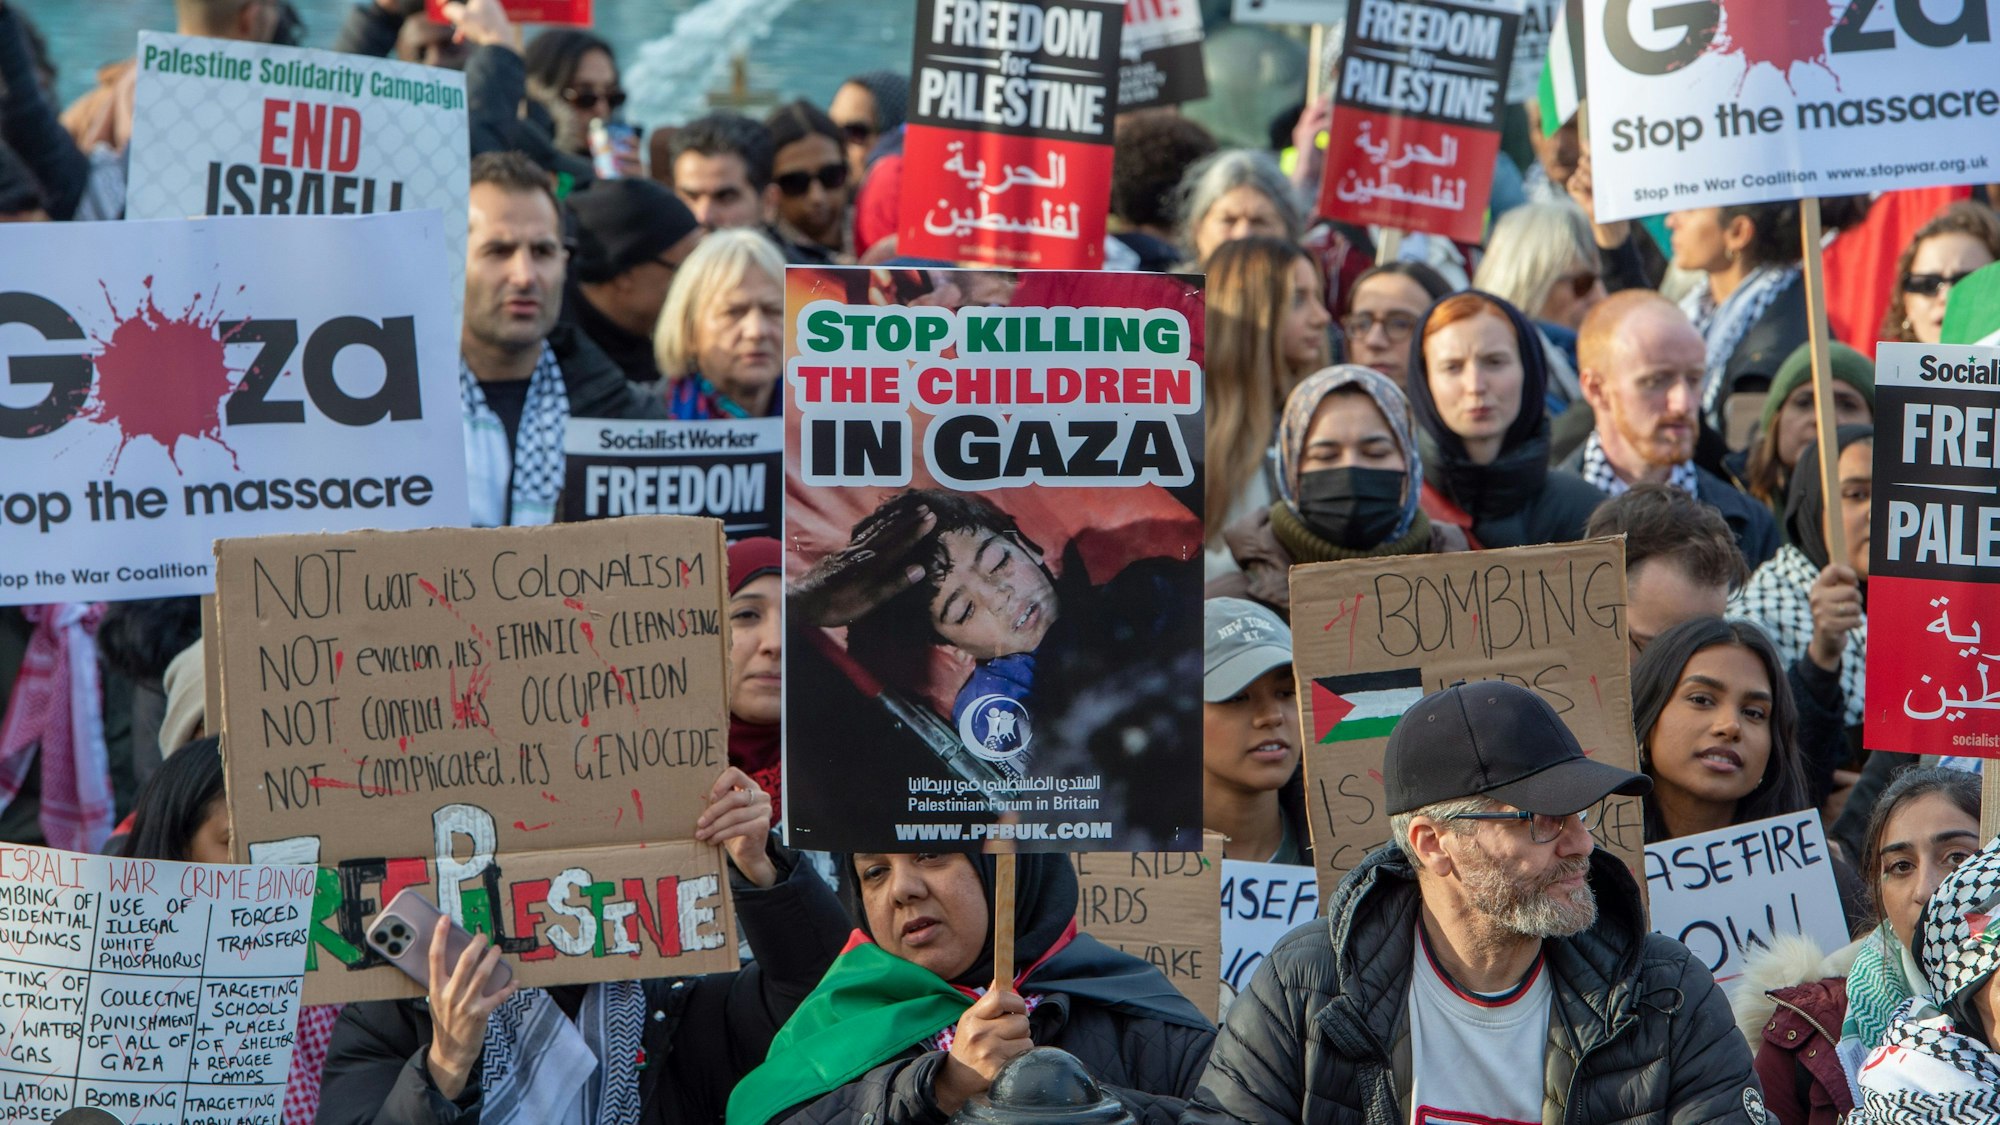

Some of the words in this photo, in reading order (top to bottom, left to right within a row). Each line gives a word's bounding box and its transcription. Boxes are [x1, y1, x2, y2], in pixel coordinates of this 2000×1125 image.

[932, 0, 1103, 60] FREEDOM
[1356, 0, 1502, 60] FREEDOM
[144, 45, 252, 82] Palestine
[259, 57, 364, 98] Solidarity
[370, 71, 464, 111] Campaign
[1341, 56, 1500, 123] PALESTINE
[918, 67, 1106, 134] PALESTINE
[260, 97, 362, 173] END
[1612, 116, 1704, 152] Stop
[1715, 102, 1784, 138] the
[1797, 89, 2000, 130] massacre
[1355, 121, 1459, 168] الحرية
[943, 141, 1067, 195] الحرية
[1634, 187, 1669, 203] Stop
[1674, 182, 1700, 196] the
[1704, 176, 1737, 192] War
[1742, 168, 1818, 189] Coalition
[1827, 155, 1989, 181] www.stopwar.org.uk
[1337, 168, 1467, 211] لفلسطين
[924, 192, 1080, 240] لفلسطين
[806, 309, 949, 353] STOP
[966, 316, 1181, 354] KILLING
[0, 290, 423, 439] Gza
[1919, 354, 2000, 386] Social
[797, 366, 900, 404] THE
[917, 367, 1191, 405] CHILDREN
[811, 420, 902, 476] IN
[933, 414, 1184, 480] GAZA
[1902, 402, 2000, 469] FRE
[0, 491, 72, 534] op
[85, 480, 168, 522] the
[183, 474, 434, 516] massacre
[585, 461, 768, 517] FREEDOM
[1887, 500, 2000, 567] PALE
[35, 569, 66, 586] the
[72, 566, 110, 584] War
[116, 561, 208, 582] Coalition
[253, 549, 357, 621] NOT
[1374, 560, 1628, 660] BOMBING
[1217, 618, 1243, 641] NEW
[258, 634, 340, 692] NOT
[497, 617, 580, 661] ETHNIC
[609, 607, 720, 649] CLEANSING
[262, 696, 341, 749] NOT
[521, 656, 688, 726] OCCUPATION
[1952, 733, 2000, 748] socialist
[264, 762, 326, 812] NOT
[574, 727, 720, 782] GENOCIDE
[908, 797, 985, 812] Palestinian
[989, 797, 1033, 812] Forum
[1036, 796, 1049, 811] in
[1053, 795, 1100, 811] Britain
[953, 778, 979, 796] في
[1319, 773, 1376, 838] IS
[895, 821, 1113, 842] WWW.PFBUK.COM
[1131, 852, 1204, 880] KIDS
[1645, 819, 1823, 891] ASEFIRE
[0, 847, 88, 889] ISRALI
[109, 860, 160, 896] WAR
[180, 864, 251, 901] CRIME
[256, 866, 317, 903] BINGO
[74, 893, 94, 911] OF
[110, 897, 145, 917] USE
[166, 897, 193, 914] OF
[230, 905, 299, 928] FORCED
[1082, 884, 1148, 927] IRDS
[1221, 875, 1319, 926] ASEF
[0, 907, 92, 929] SIDENTIAL
[105, 918, 180, 935] ILLEGAL
[101, 937, 156, 952] WHITE
[217, 928, 307, 953] TRANSFERS
[99, 951, 202, 971] PHOSPHORUS
[1144, 945, 1203, 980] AKE
[62, 975, 88, 992] OF
[100, 988, 198, 1009] COLLECTIVE
[206, 979, 298, 999] TARGETING
[90, 1013, 195, 1033] PUNISHMENT
[211, 999, 289, 1017] SCHOOLS
[87, 1034, 113, 1049] OF
[125, 1034, 161, 1050] ALL
[168, 1033, 190, 1048] OF
[196, 1039, 224, 1053] OF
[239, 1031, 295, 1051] SHELTER
[225, 1017, 285, 1037] PLACES
[10, 1044, 52, 1064] GAS
[100, 1053, 164, 1072] GAZA
[207, 1053, 273, 1071] REFUGEE
[3, 1081, 68, 1103] LATION
[211, 1069, 264, 1085] CAMPS
[85, 1087, 177, 1110] BOMBING
[184, 1093, 275, 1113] TARGETING
